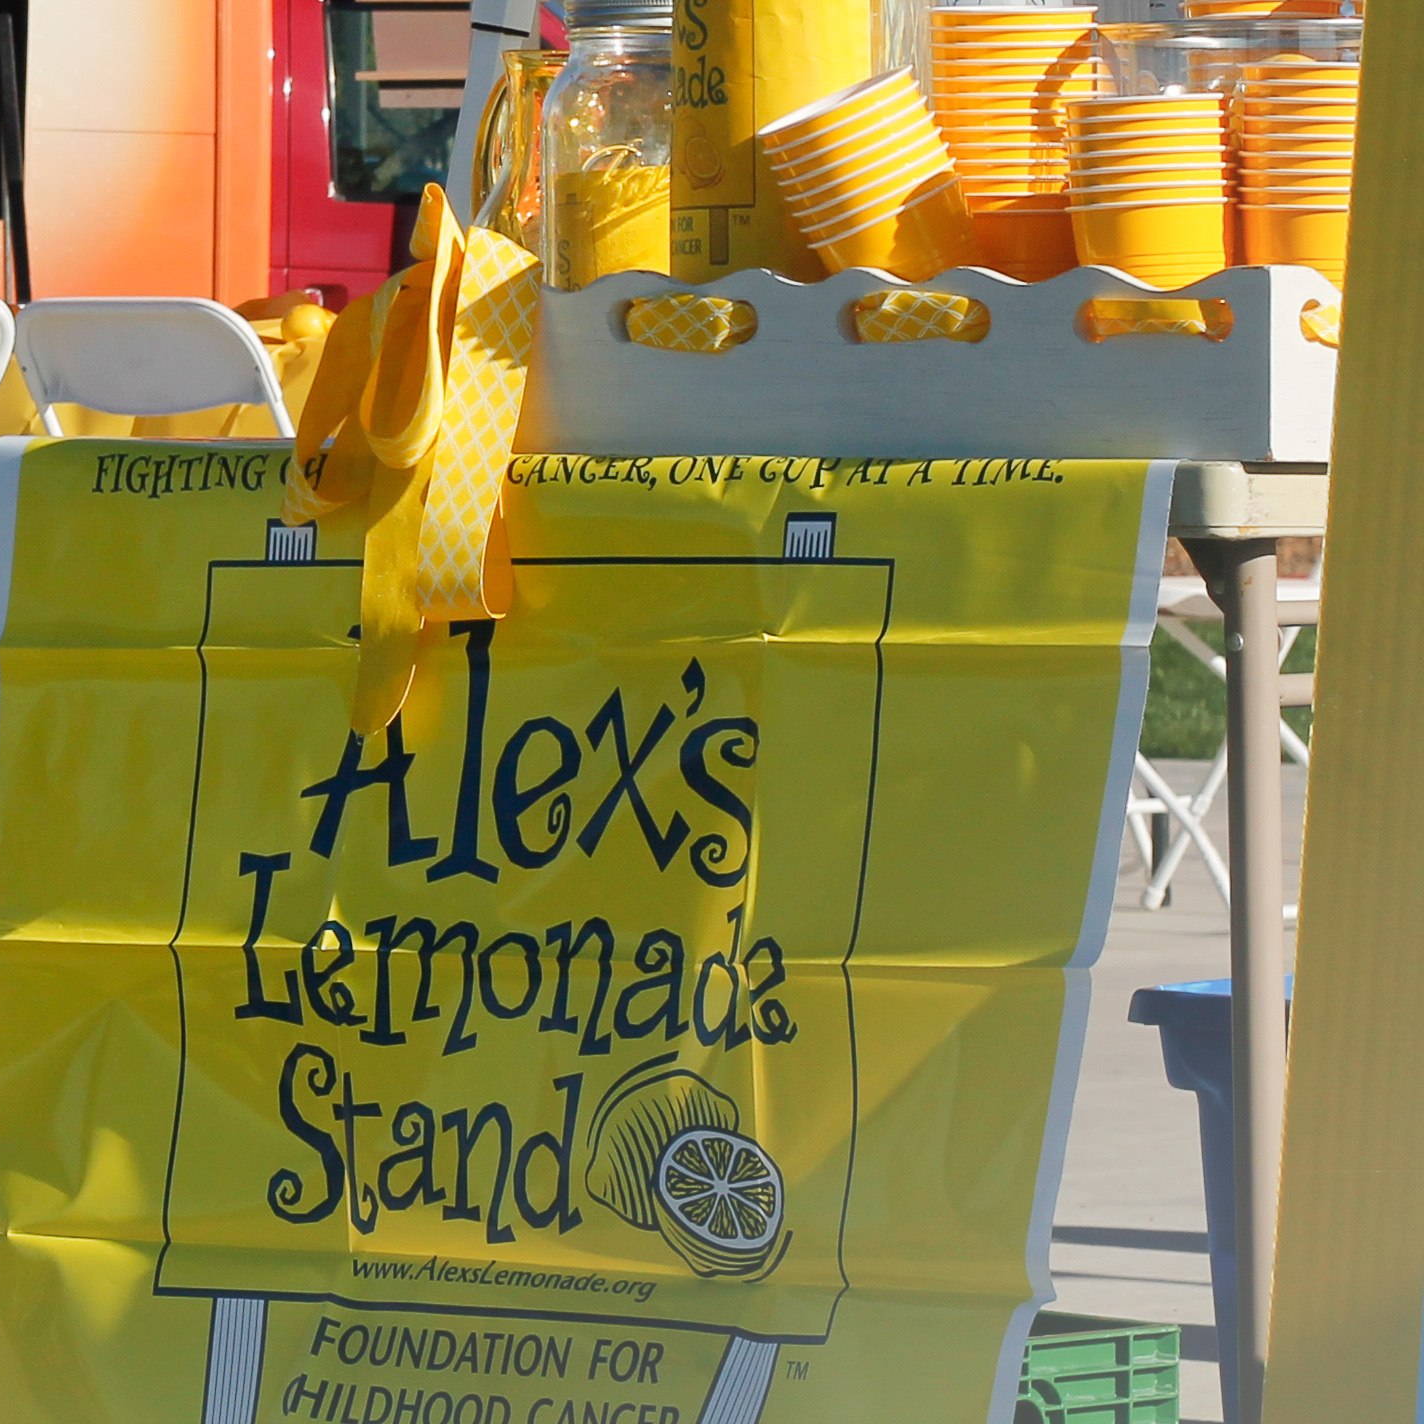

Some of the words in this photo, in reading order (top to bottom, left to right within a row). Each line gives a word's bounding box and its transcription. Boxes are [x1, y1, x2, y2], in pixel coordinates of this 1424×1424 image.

[91, 452, 269, 500] FIGHTING
[507, 454, 658, 492] CANCER,
[668, 454, 752, 485] ONE
[757, 456, 844, 490] CUP
[846, 456, 897, 487] AT
[906, 456, 934, 487] A
[950, 457, 1065, 488] TIME.
[299, 619, 761, 888] Alex's
[234, 851, 798, 1057] Lemonade
[267, 1043, 585, 1245] Stand
[352, 1255, 657, 1304] www.AlexsLemonade.org
[309, 1316, 574, 1379] FOUNDATION
[588, 1339, 665, 1384] FOR
[785, 1360, 810, 1381] TM
[281, 1373, 512, 1424] CHILDHOOD
